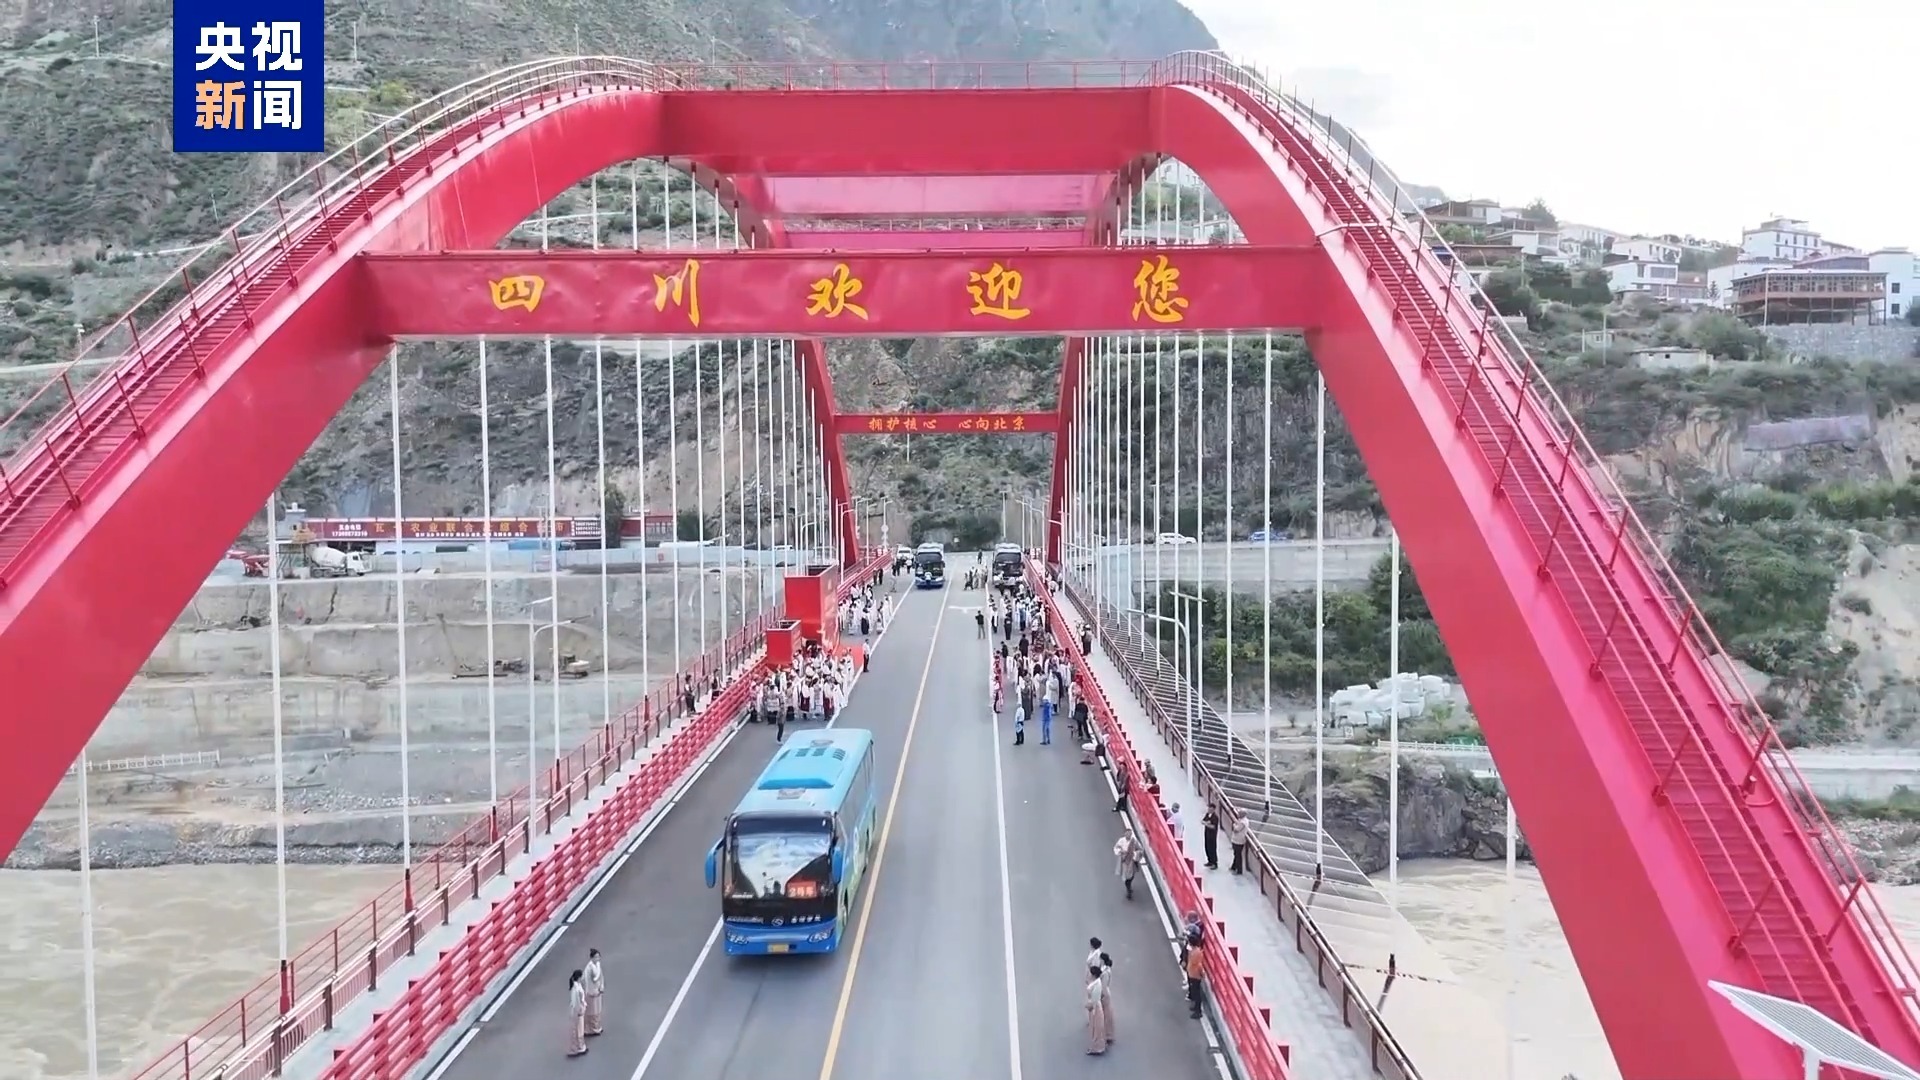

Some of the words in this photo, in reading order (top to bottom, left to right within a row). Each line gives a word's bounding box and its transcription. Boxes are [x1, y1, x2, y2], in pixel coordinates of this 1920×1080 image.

[490, 258, 1189, 327] 四川欢迎您
[868, 416, 937, 431] 拥护核心
[958, 416, 1026, 431] 心向北京
